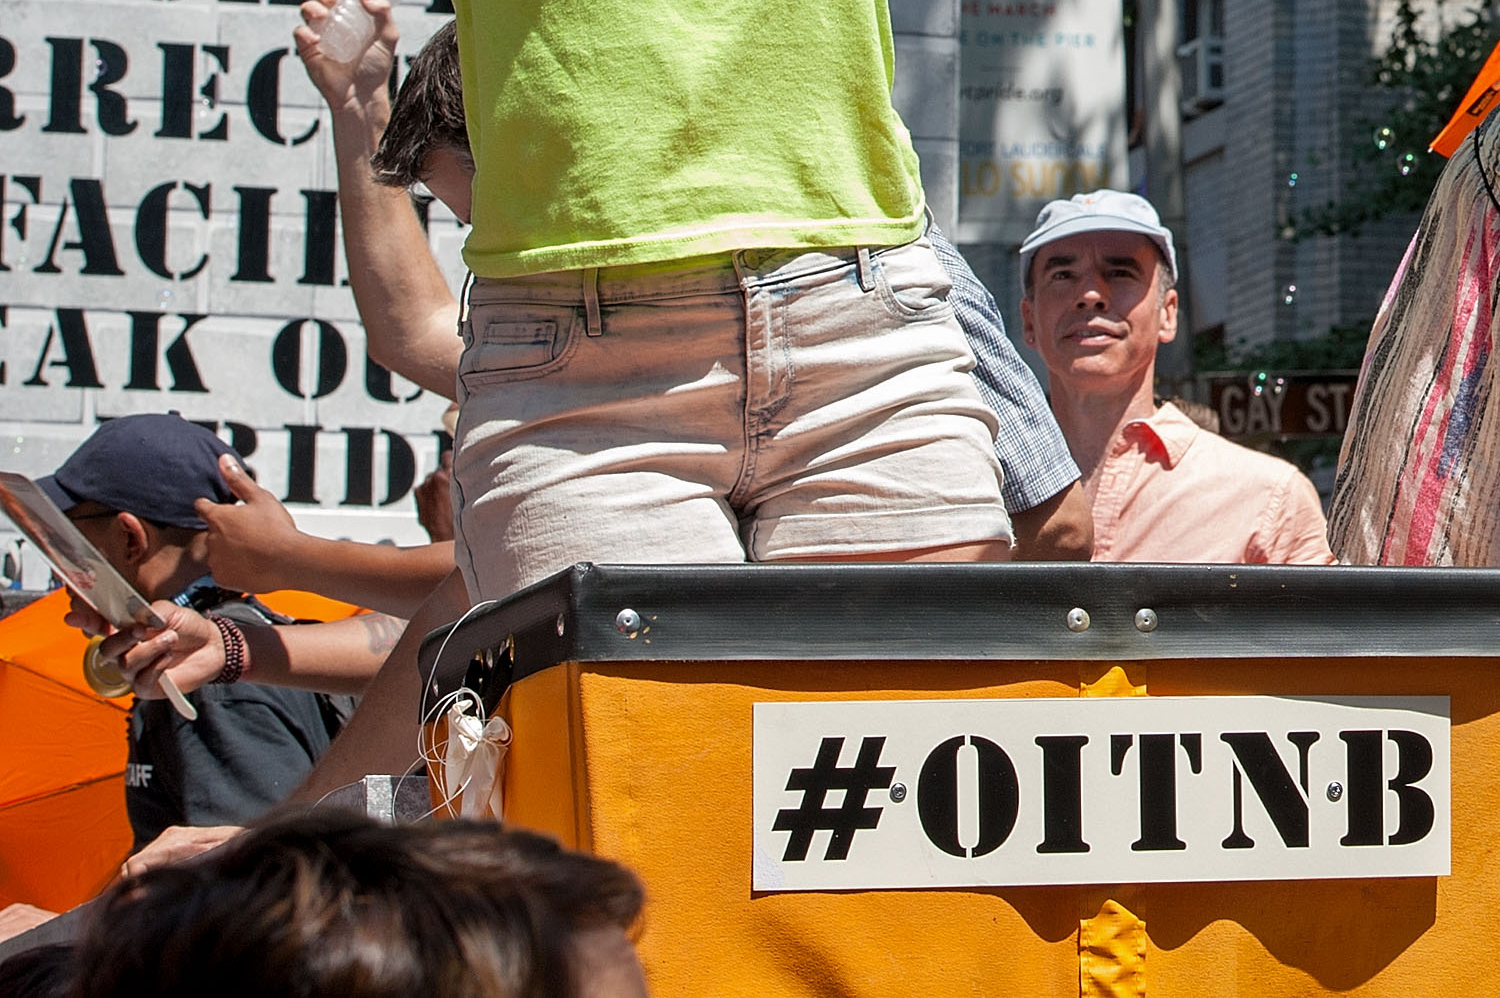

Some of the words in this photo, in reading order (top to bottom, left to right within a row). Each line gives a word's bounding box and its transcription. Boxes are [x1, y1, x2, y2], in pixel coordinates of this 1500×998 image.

[1220, 384, 1287, 434] GAY
[1305, 383, 1350, 432] ST
[771, 729, 1435, 862] #OITNB
